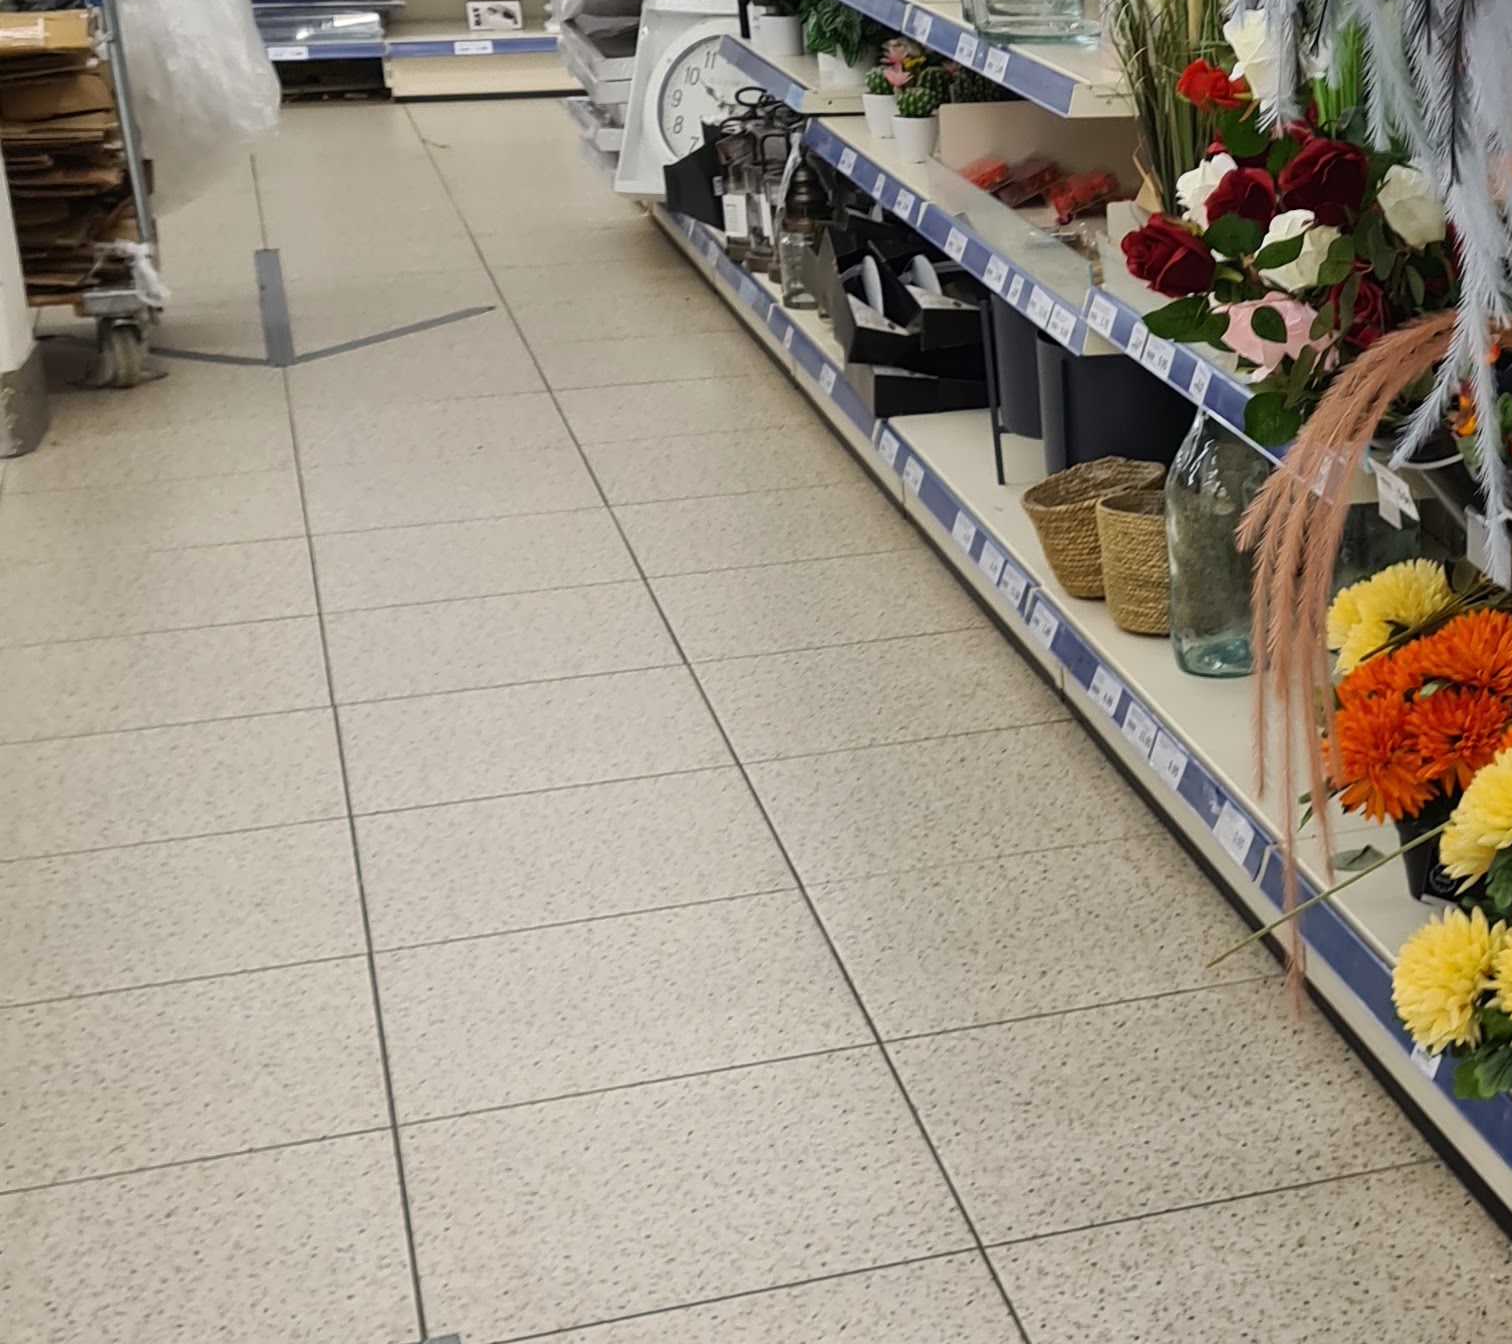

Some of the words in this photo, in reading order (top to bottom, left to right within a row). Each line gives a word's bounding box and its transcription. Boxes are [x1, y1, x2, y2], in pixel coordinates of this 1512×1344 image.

[684, 66, 701, 85] 10
[671, 89, 683, 107] 9
[673, 115, 684, 134] 8
